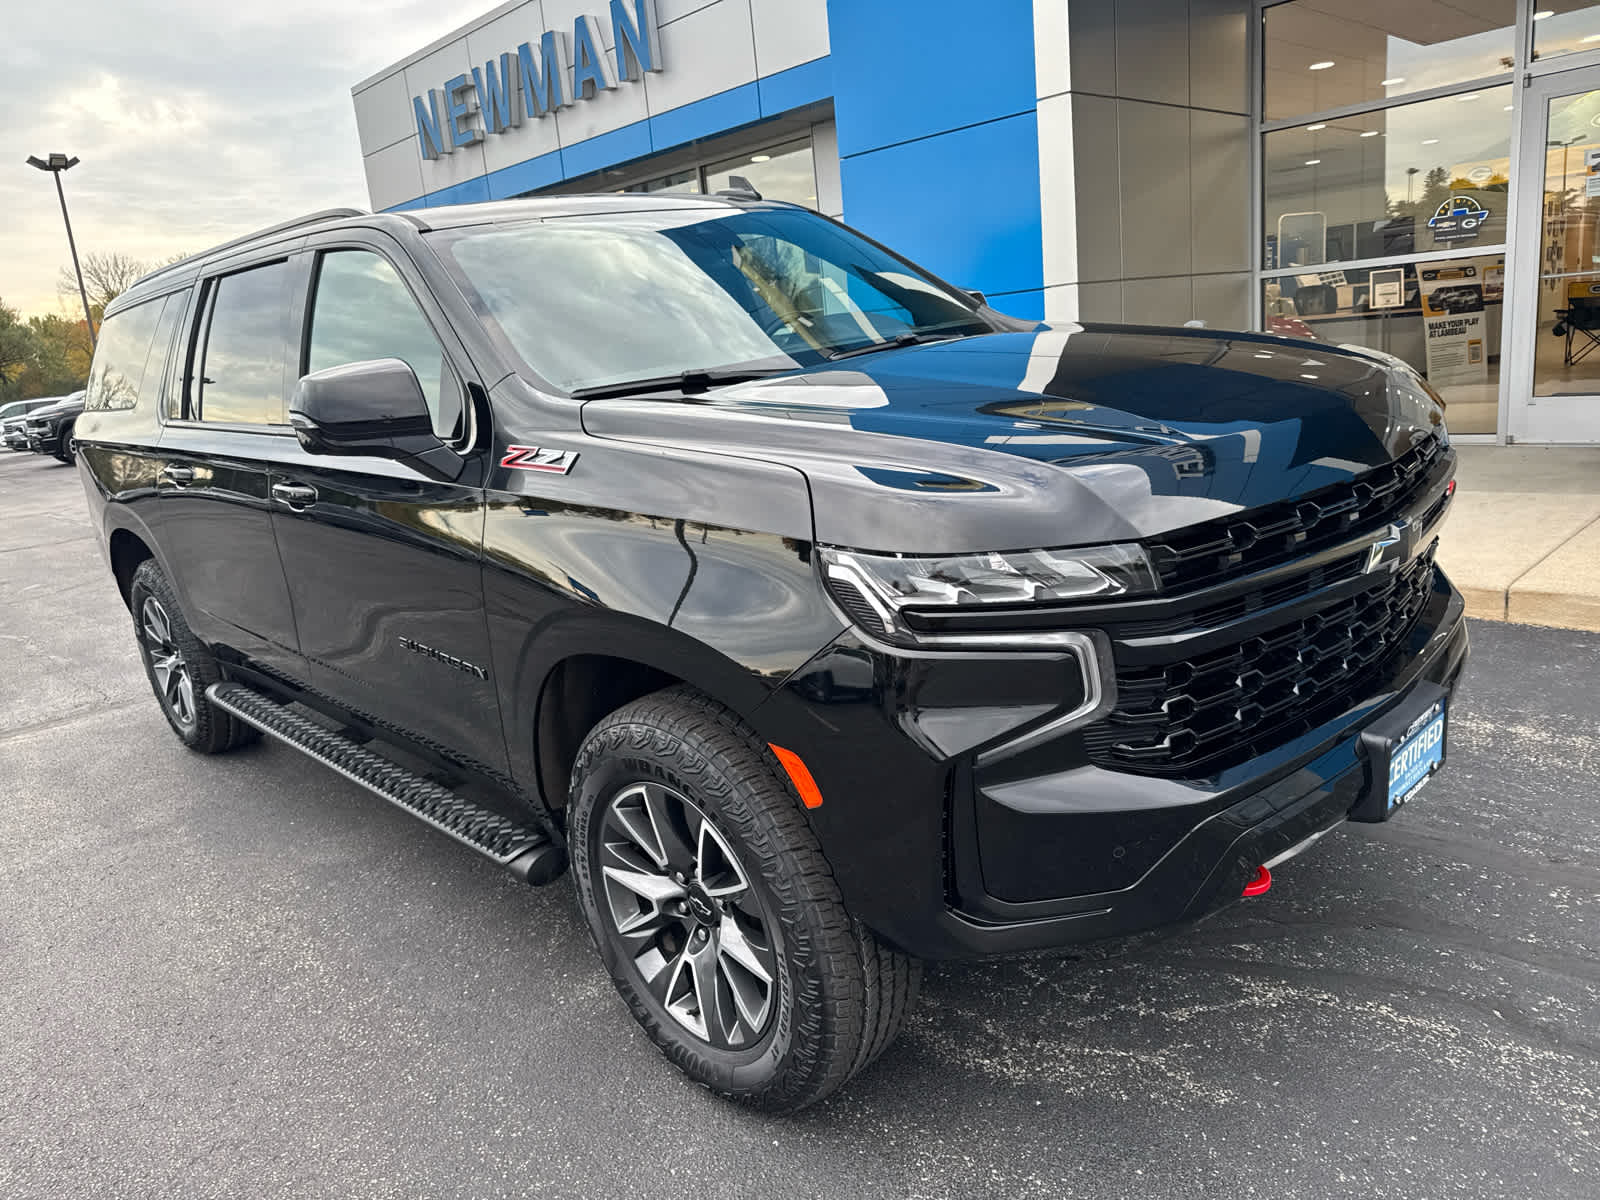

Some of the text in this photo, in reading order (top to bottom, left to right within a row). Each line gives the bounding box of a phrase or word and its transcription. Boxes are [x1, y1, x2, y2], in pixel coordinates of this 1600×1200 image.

[413, 0, 663, 160] NEWMAN
[1428, 317, 1480, 330] MAKE YOUR PLAY
[1428, 329, 1437, 338] AT
[500, 444, 580, 475] Z71
[1388, 719, 1444, 787] CERTIFIED
